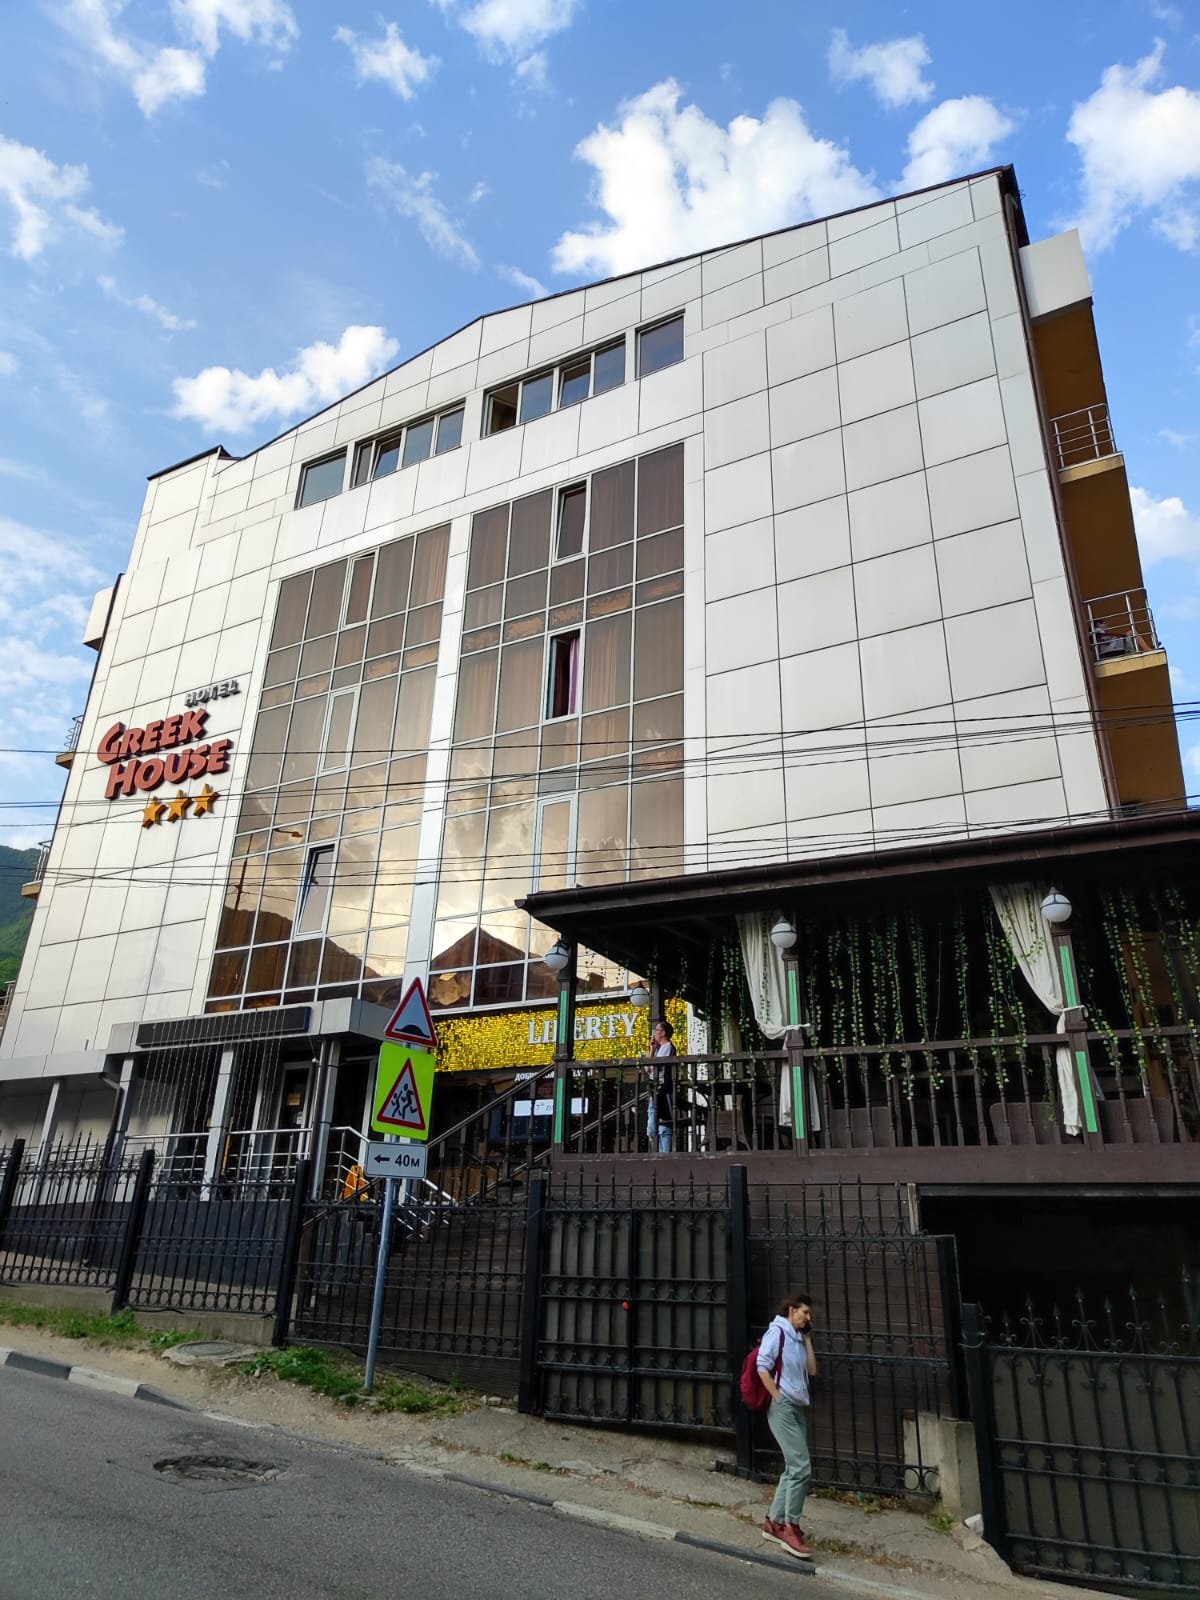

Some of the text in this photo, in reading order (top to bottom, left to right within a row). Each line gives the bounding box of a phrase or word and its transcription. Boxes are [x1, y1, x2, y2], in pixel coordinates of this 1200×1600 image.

[185, 680, 241, 707] HOTEL
[97, 708, 210, 765] GREEK
[104, 738, 234, 799] HOUSE
